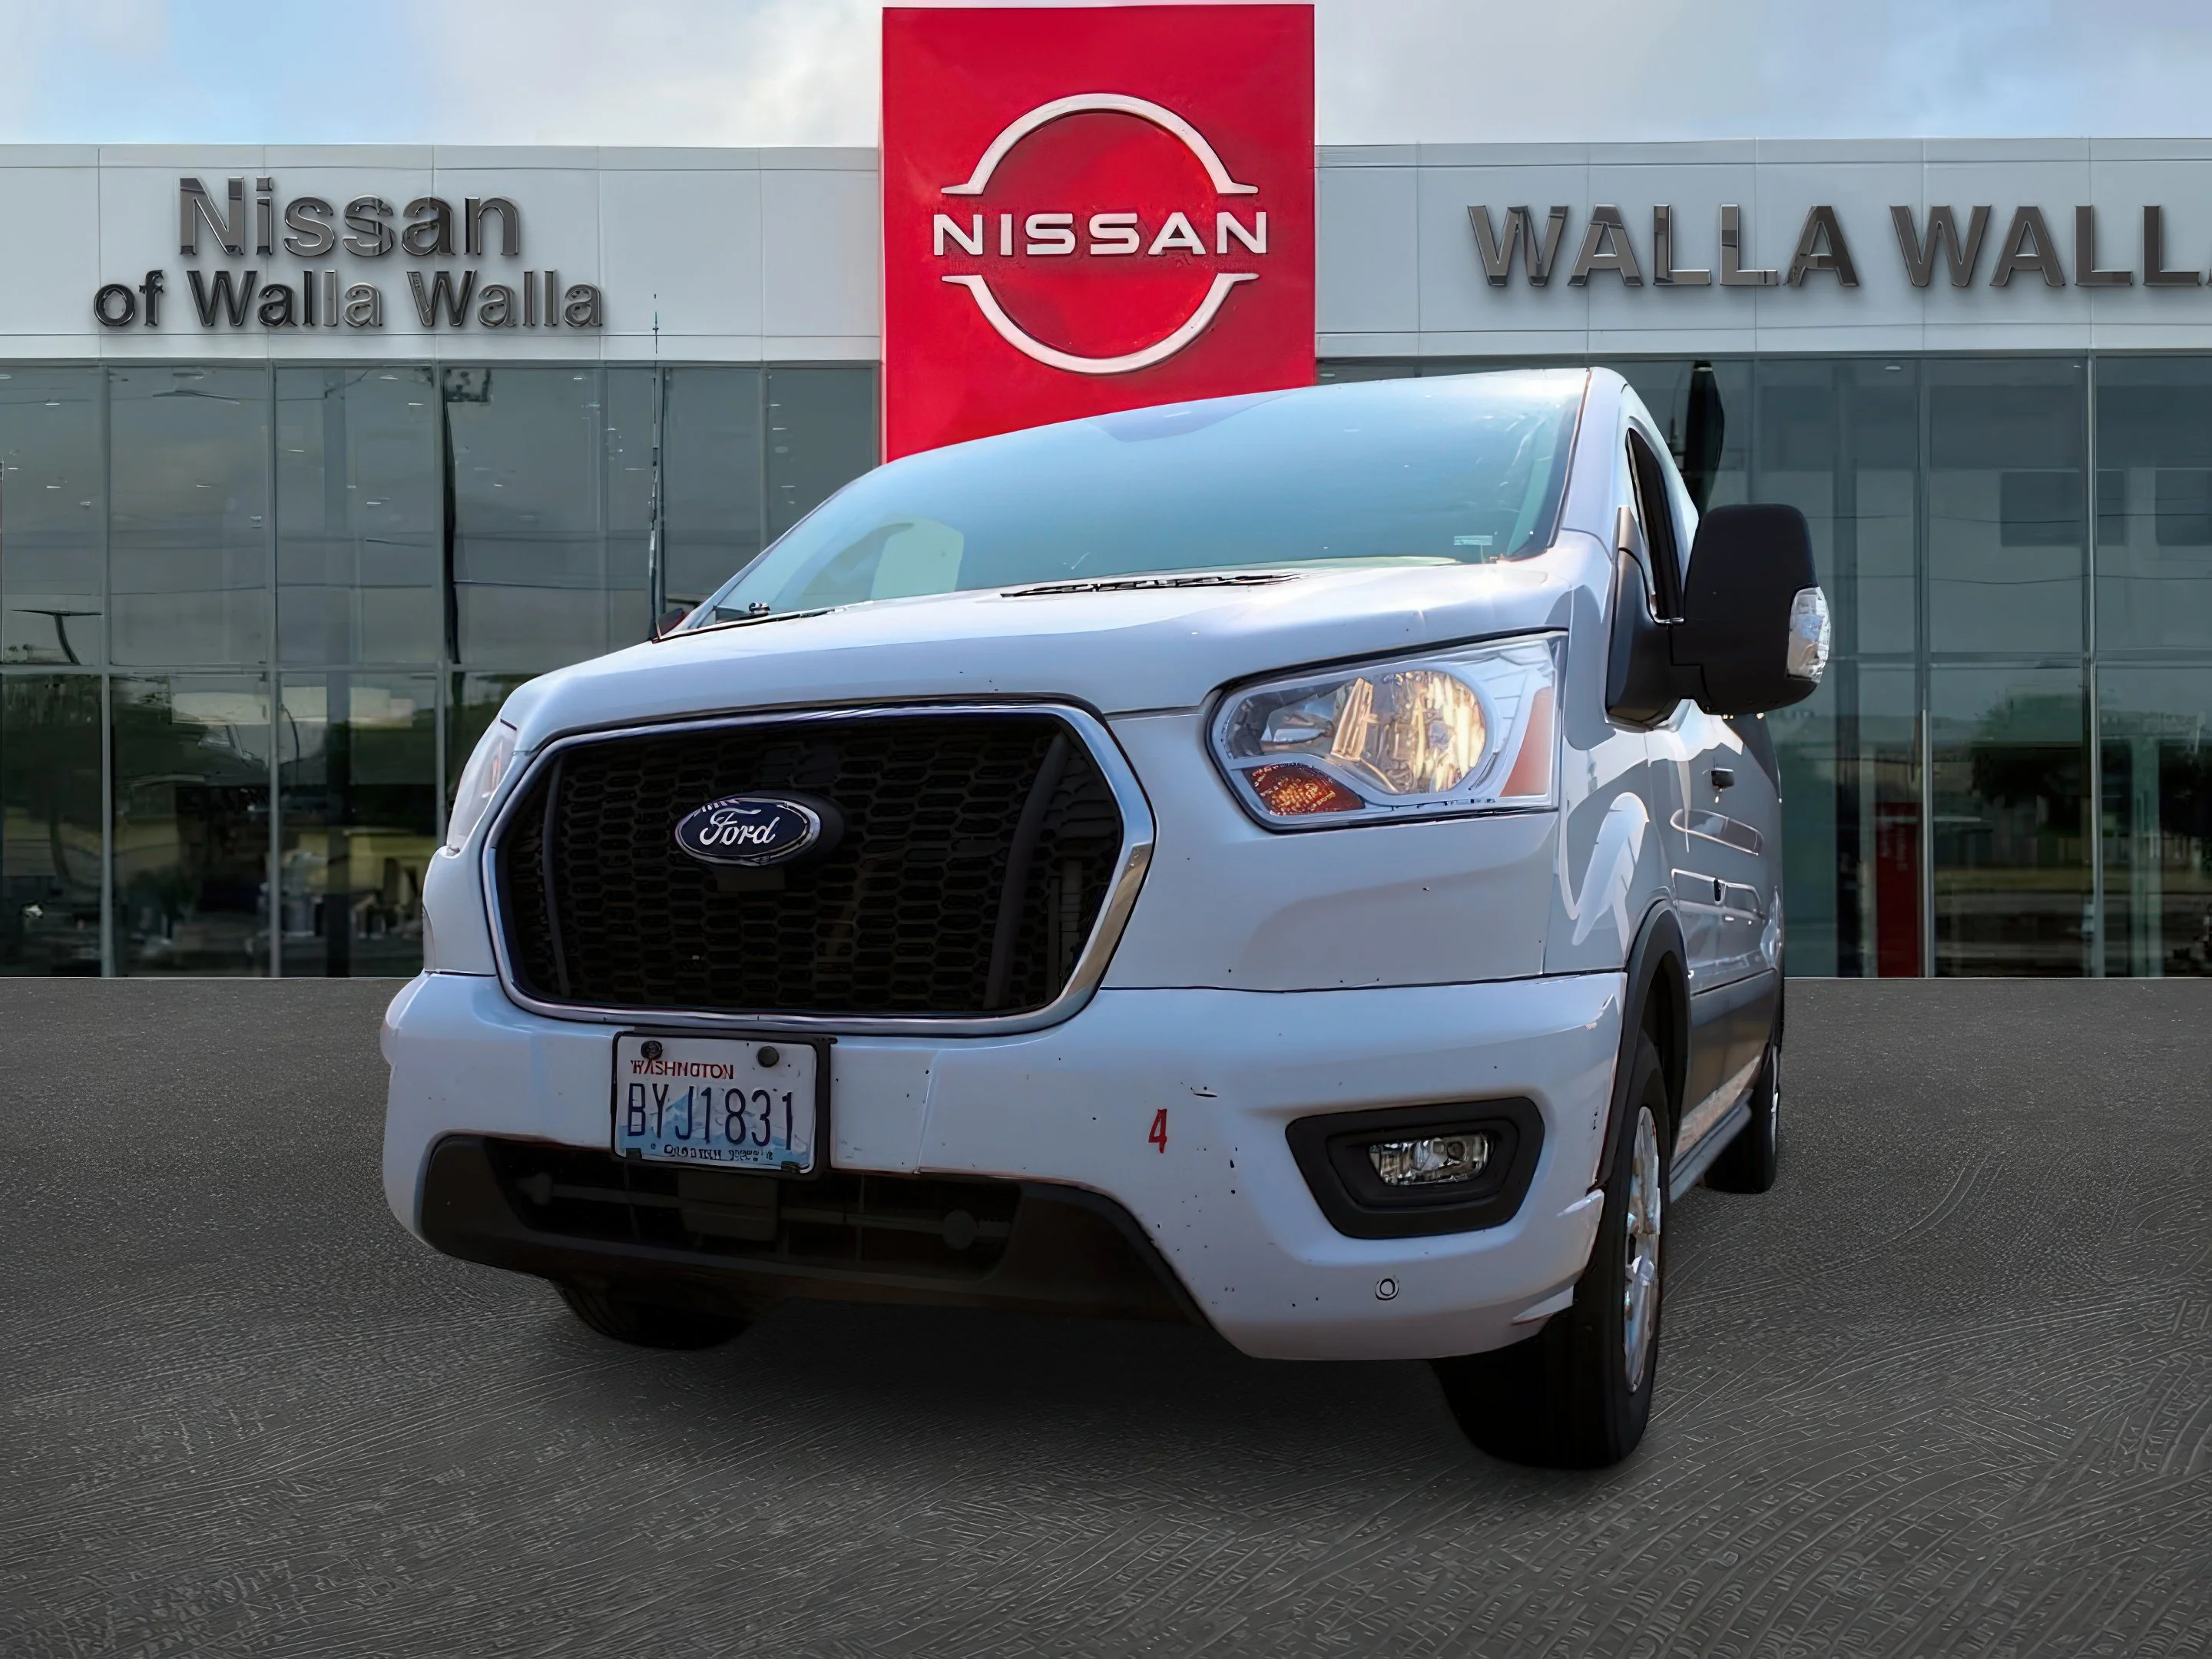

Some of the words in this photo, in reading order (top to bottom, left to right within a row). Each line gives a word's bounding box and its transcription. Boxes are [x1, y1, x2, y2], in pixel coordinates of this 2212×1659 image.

[179, 177, 520, 257] Nissan
[933, 211, 1267, 256] NISSAN
[1466, 204, 1859, 287] WALLA
[1889, 204, 2212, 287] WALL
[93, 269, 164, 327] of
[186, 269, 383, 328] Walla
[406, 269, 603, 328] Walla
[699, 807, 780, 845] Ford
[631, 1059, 734, 1080] WASHNGTON
[627, 1082, 793, 1151] BYJ1831
[1148, 1108, 1167, 1154] 4
